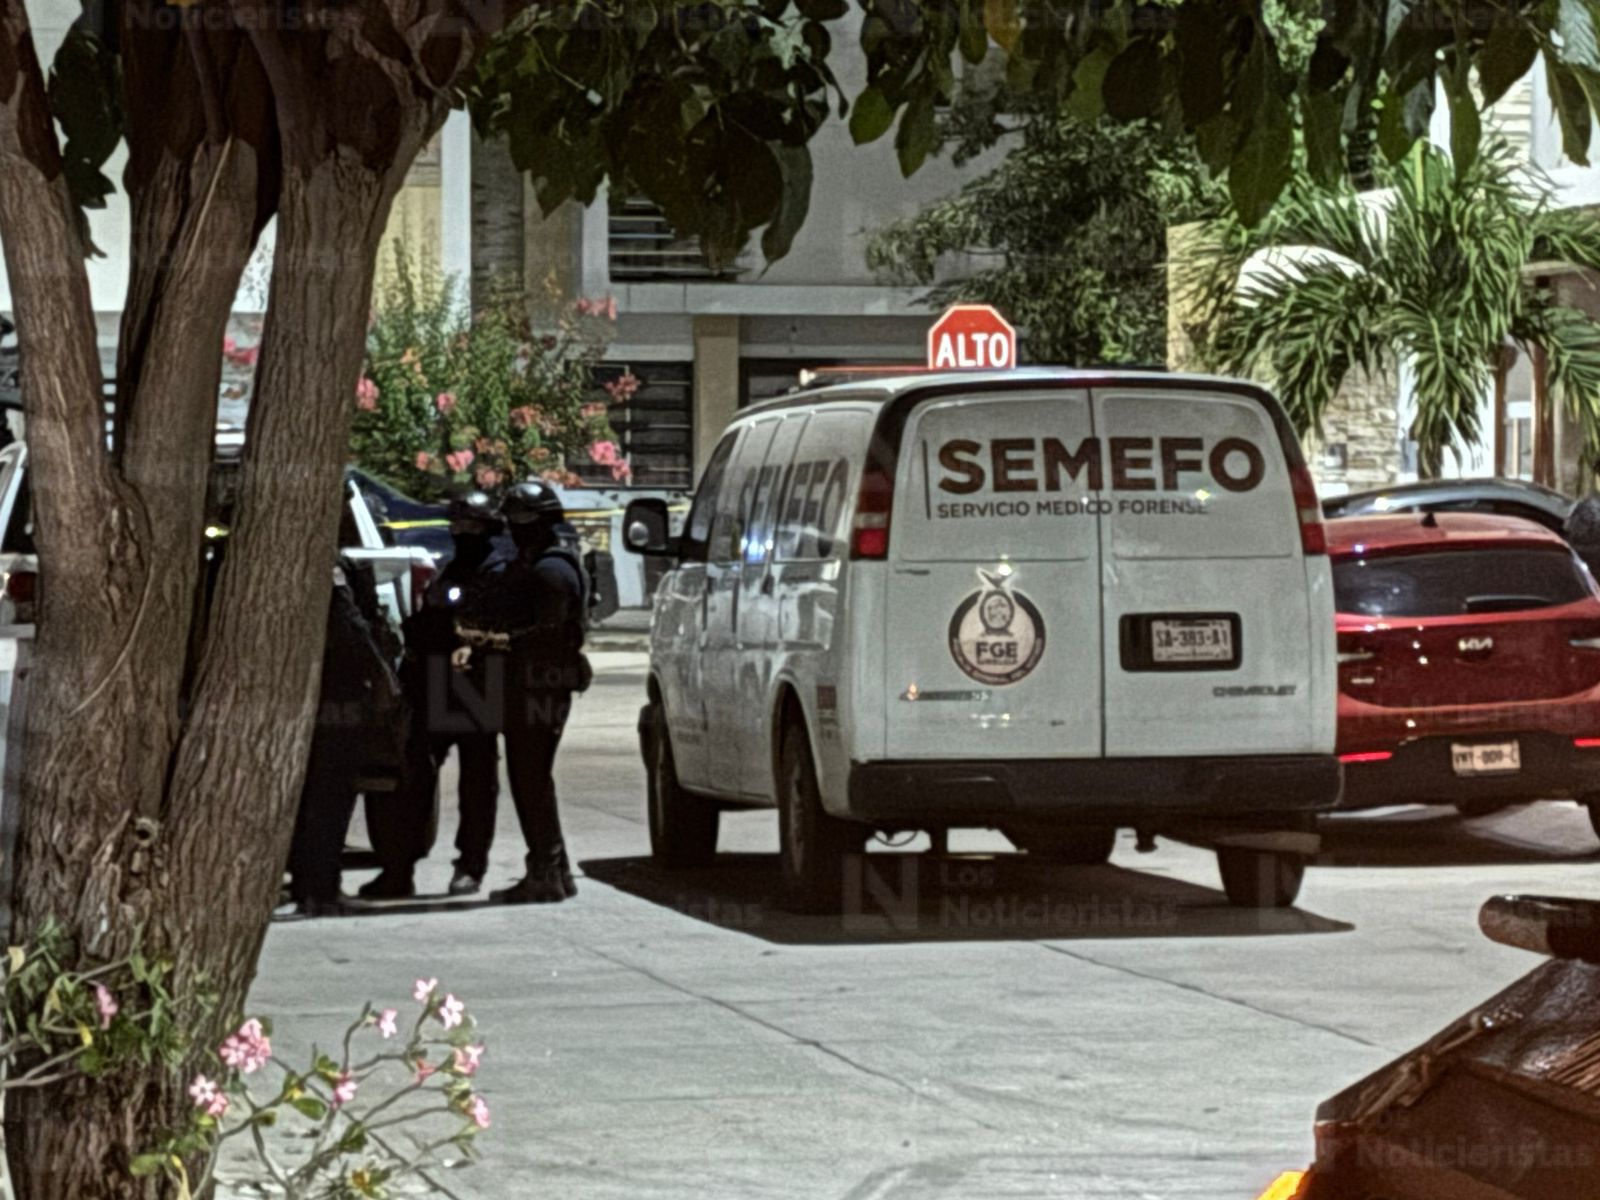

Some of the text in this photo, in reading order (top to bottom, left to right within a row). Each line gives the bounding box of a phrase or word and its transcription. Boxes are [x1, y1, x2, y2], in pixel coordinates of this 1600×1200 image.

[936, 332, 1009, 368] ALTO
[938, 437, 1265, 494] SEMEFO
[937, 500, 1208, 519] SERVICIO MEDICO FORENSE
[976, 641, 1018, 658] FGE
